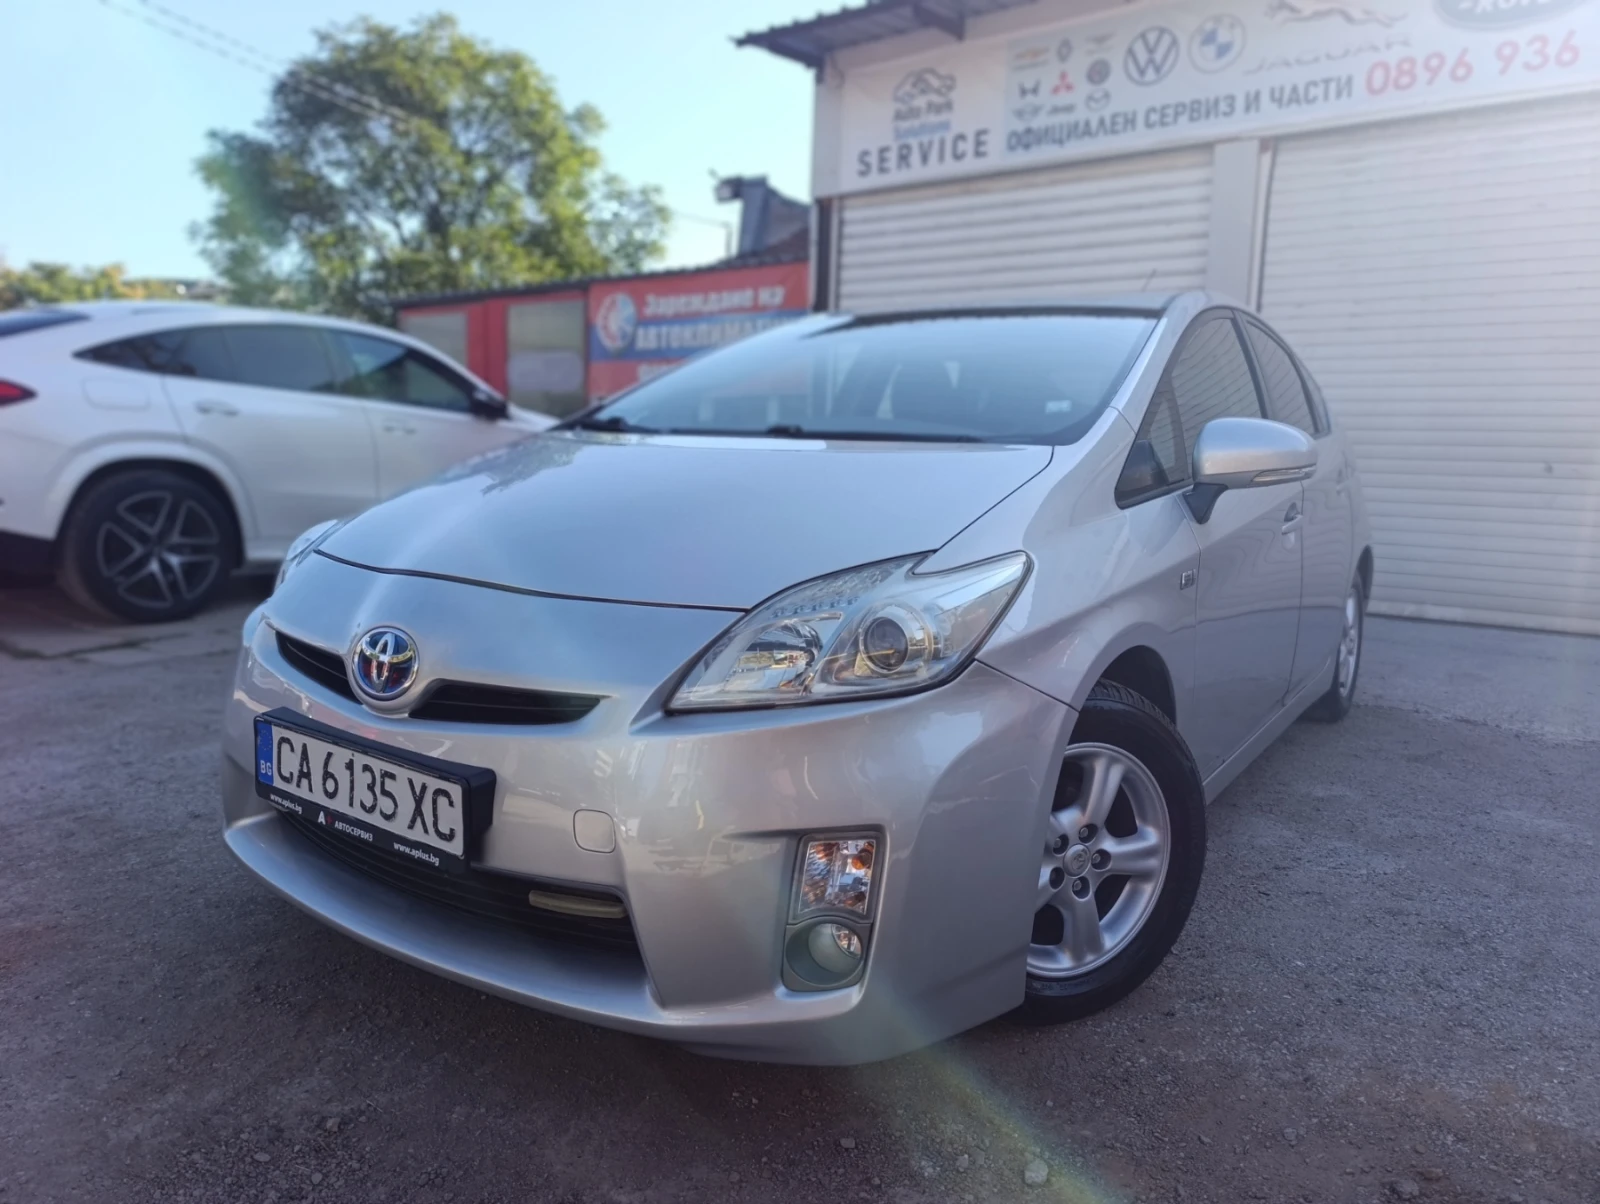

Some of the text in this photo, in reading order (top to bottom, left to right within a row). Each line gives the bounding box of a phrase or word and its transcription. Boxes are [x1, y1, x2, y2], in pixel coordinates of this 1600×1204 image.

[1006, 29, 1581, 152] ОФИЦИАЛЕН СЕРВИЗ И ЧАСТИ 0896 936
[857, 129, 990, 178] SERVICE
[260, 759, 273, 777] BG
[270, 793, 303, 815] www.aplus.bg
[334, 820, 374, 842] АВТОСЕРВИЗ
[393, 842, 440, 867] www.aplus.bg
